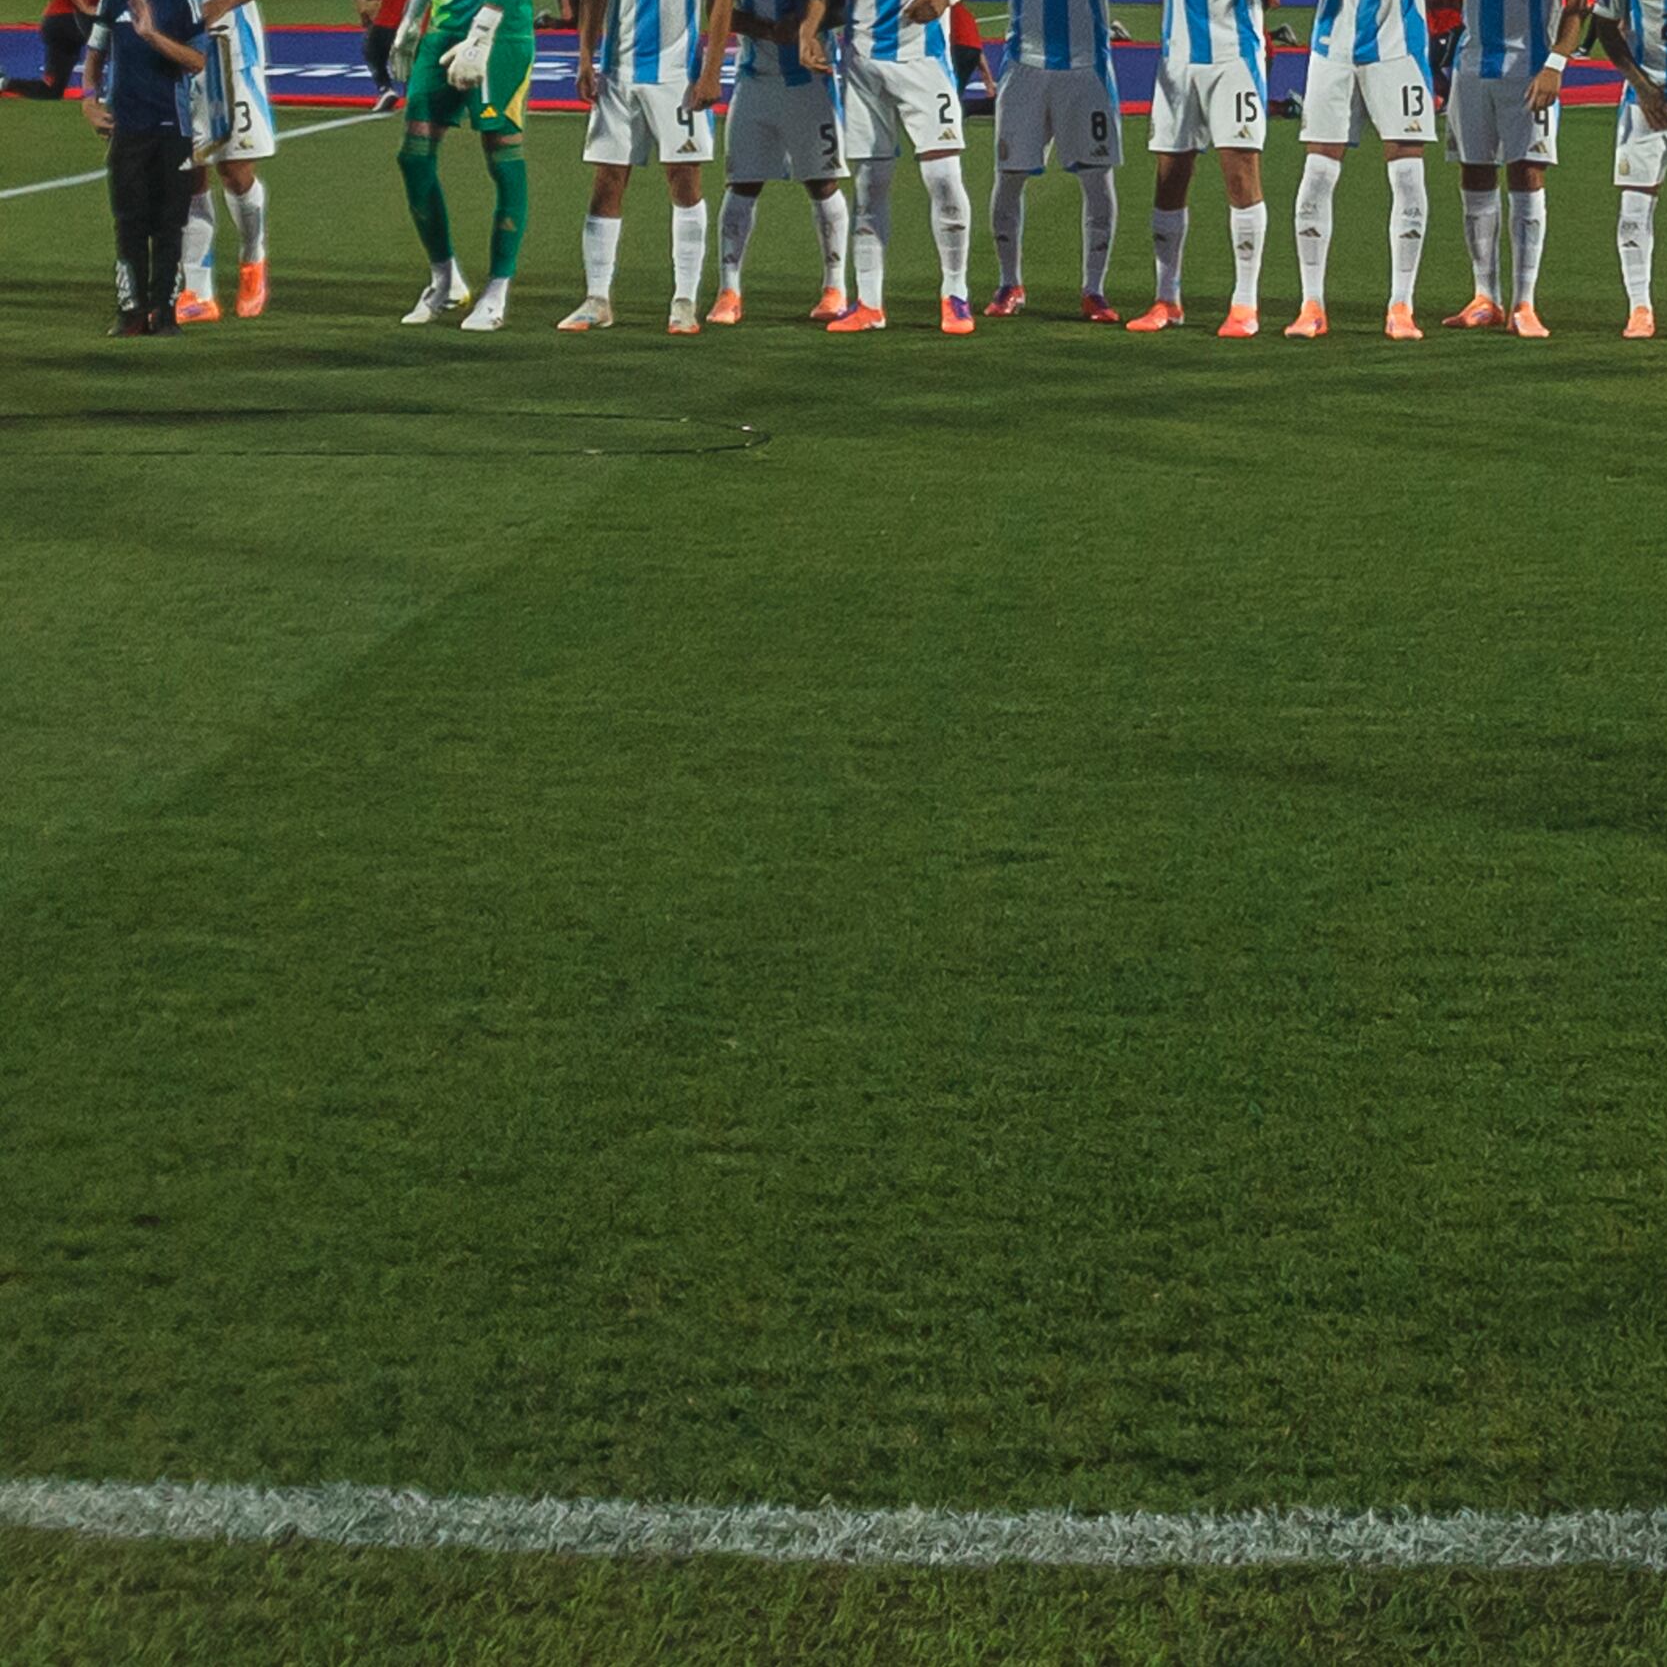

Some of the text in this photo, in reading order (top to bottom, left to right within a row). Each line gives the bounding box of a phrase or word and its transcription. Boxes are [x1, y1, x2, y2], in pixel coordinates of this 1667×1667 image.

[936, 93, 954, 124] 2
[1235, 91, 1258, 123] 15
[1402, 84, 1425, 117] 13
[818, 122, 837, 156] 5
[1090, 110, 1108, 142] 8
